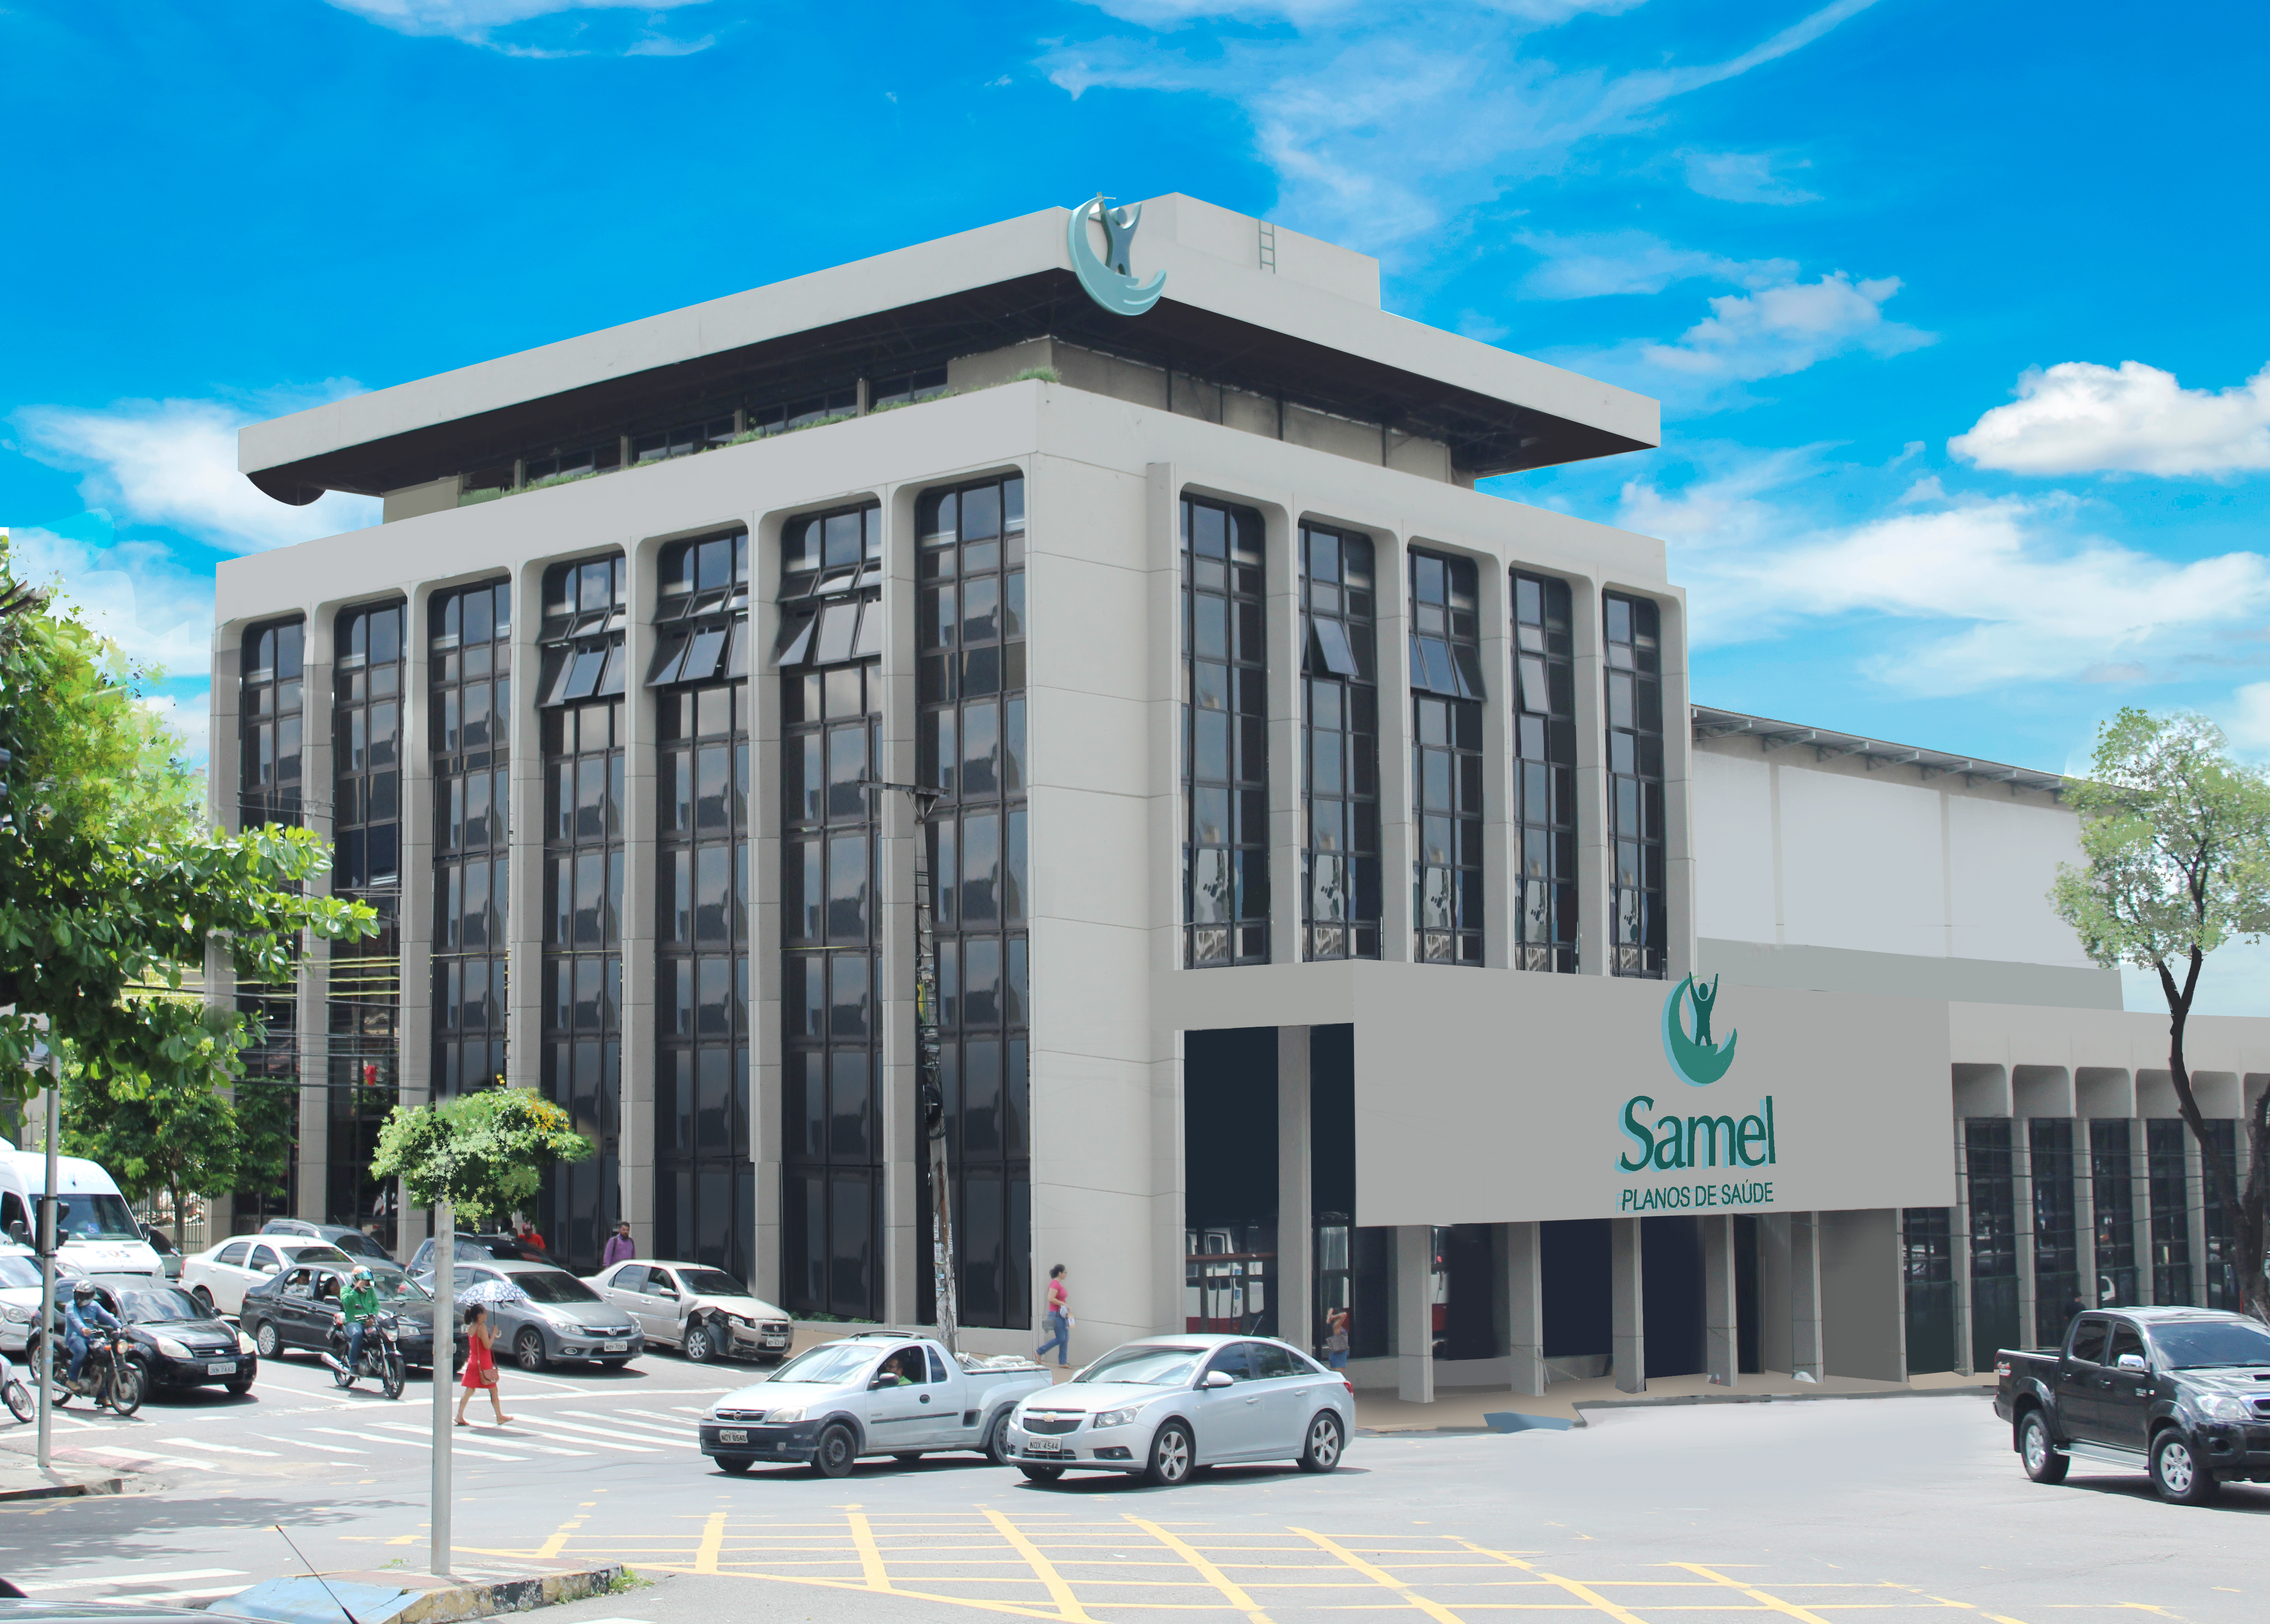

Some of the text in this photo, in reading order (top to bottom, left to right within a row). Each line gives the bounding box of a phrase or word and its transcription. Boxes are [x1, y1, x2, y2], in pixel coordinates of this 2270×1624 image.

[1620, 1095, 1776, 1171] Samel
[1622, 1179, 1774, 1211] PLANOS DE SAÚDE
